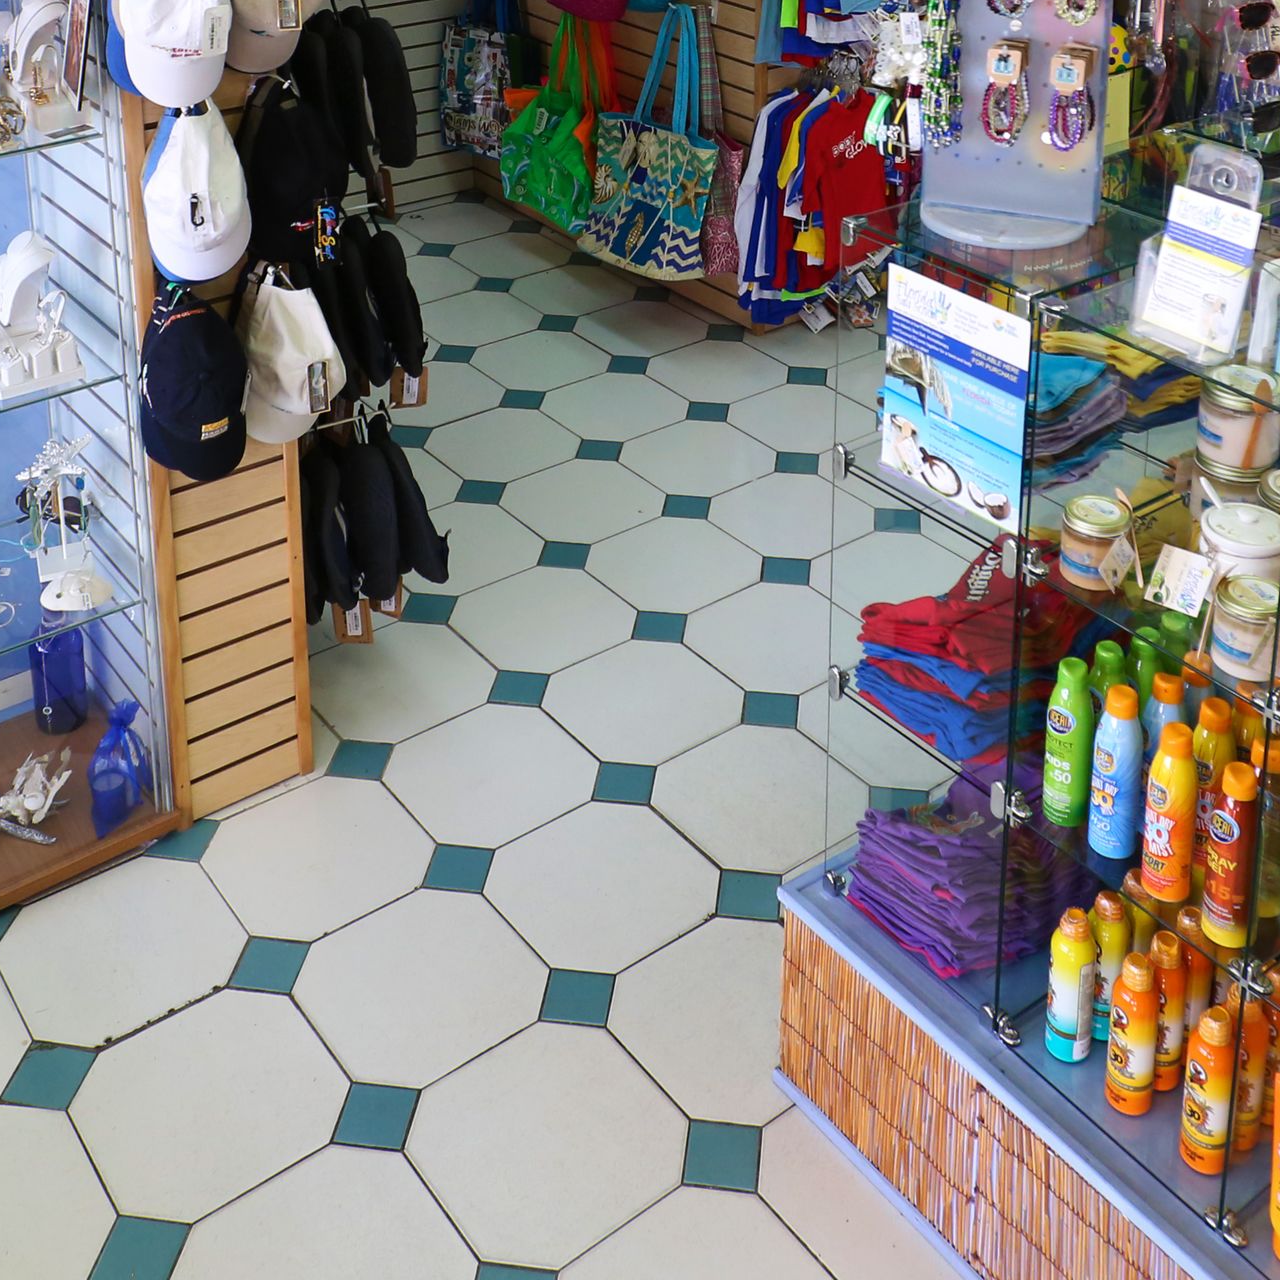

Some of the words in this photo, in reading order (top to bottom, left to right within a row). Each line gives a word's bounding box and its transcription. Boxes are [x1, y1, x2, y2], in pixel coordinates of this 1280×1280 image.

[832, 130, 856, 158] BODY
[845, 139, 868, 159] GLOV
[971, 349, 1002, 368] AVAILABLE
[1003, 361, 1020, 375] HERE
[971, 357, 985, 368] FOR
[985, 362, 1019, 384] PURCHASE
[1110, 1048, 1124, 1065] 30
[1185, 1103, 1202, 1122] 30
